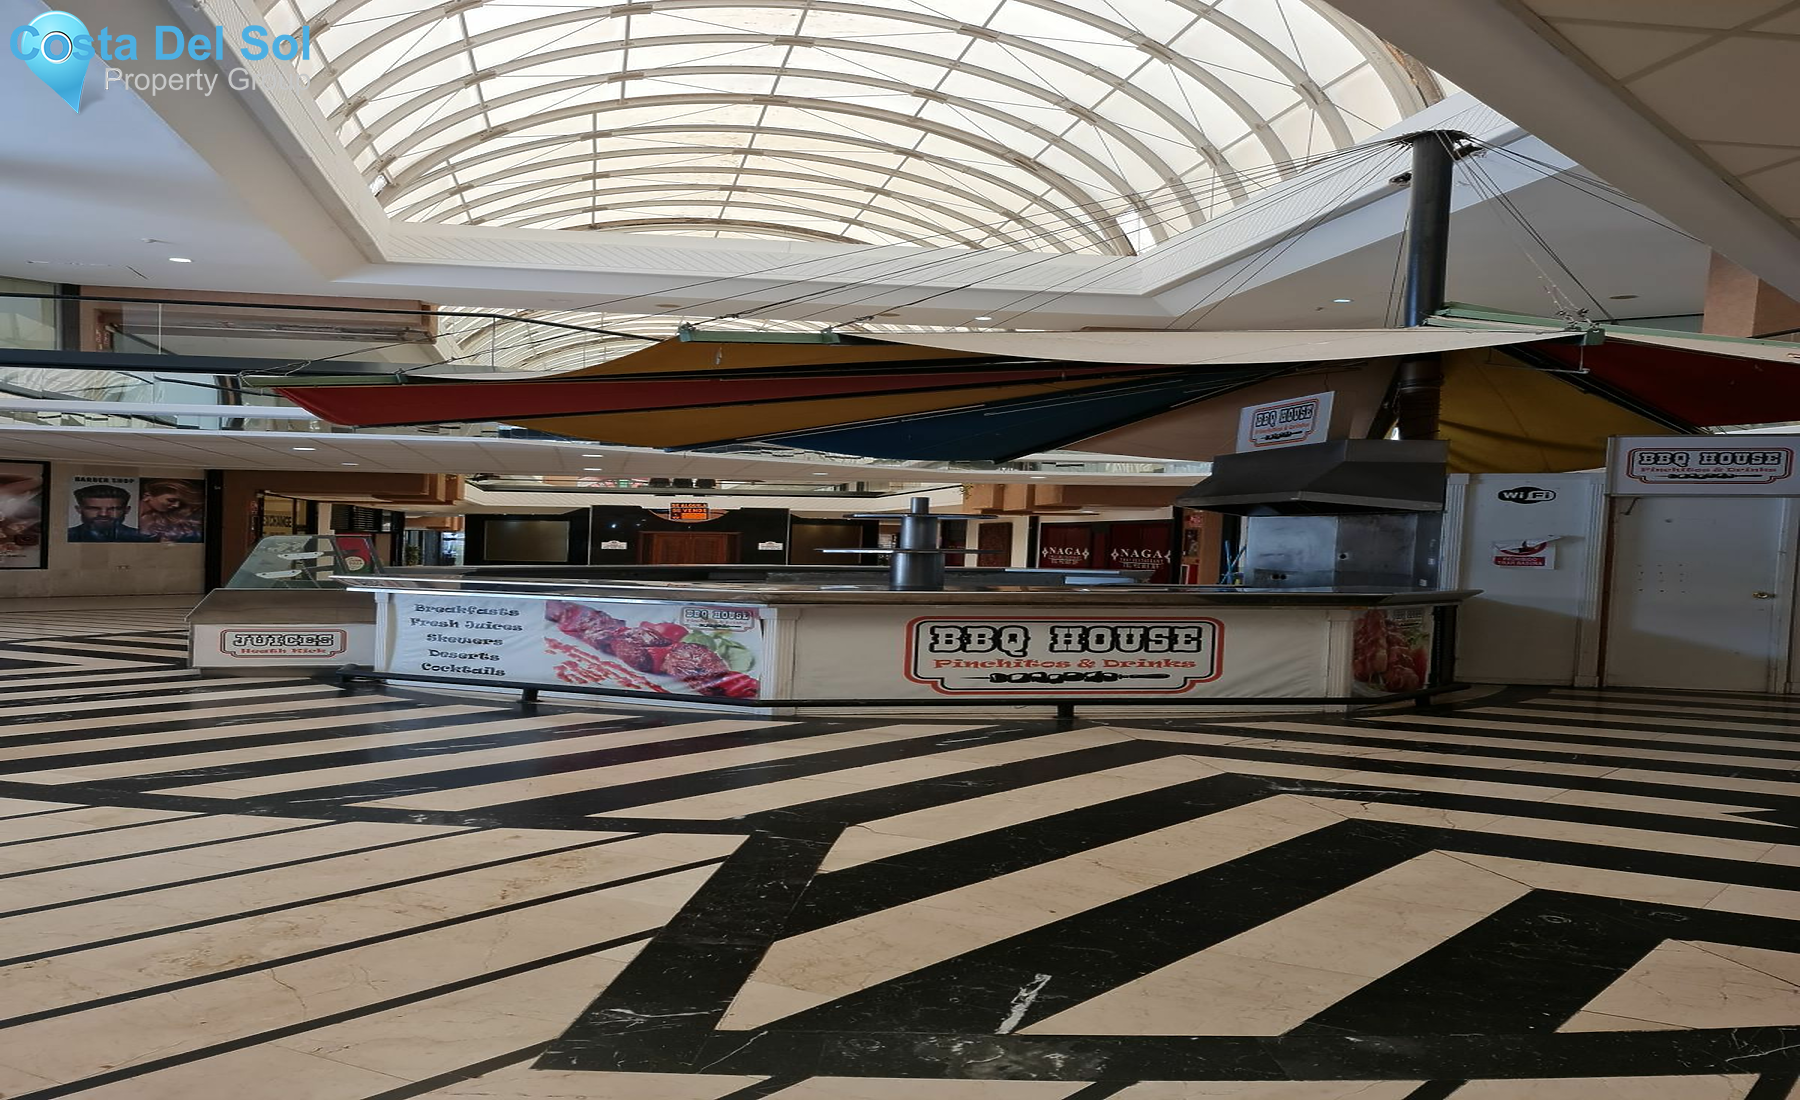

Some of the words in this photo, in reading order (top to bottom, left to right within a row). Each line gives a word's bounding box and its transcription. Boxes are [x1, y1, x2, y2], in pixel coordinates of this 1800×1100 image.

[1255, 410, 1277, 428] BBQ
[1279, 404, 1315, 423] HOUSE
[1639, 452, 1690, 467] BBQ
[1699, 452, 1781, 465] HOUSE
[1049, 547, 1081, 555] NAGA
[1120, 548, 1163, 558] NAGA
[414, 603, 520, 616] Breakfasts
[684, 609, 709, 620] BBQ
[712, 610, 750, 620] HOUSE
[409, 617, 459, 628] Fresh
[464, 621, 523, 631] Juices
[233, 633, 334, 647] JUICES
[426, 633, 503, 646] Skewers
[929, 625, 1031, 657] BBQ
[1048, 625, 1203, 653] HOUSE
[428, 649, 500, 661] Deserts
[421, 662, 506, 676] Cocktails
[933, 659, 1072, 669] Pinchitos
[1077, 658, 1096, 668] &
[1102, 658, 1197, 668] Drinks
